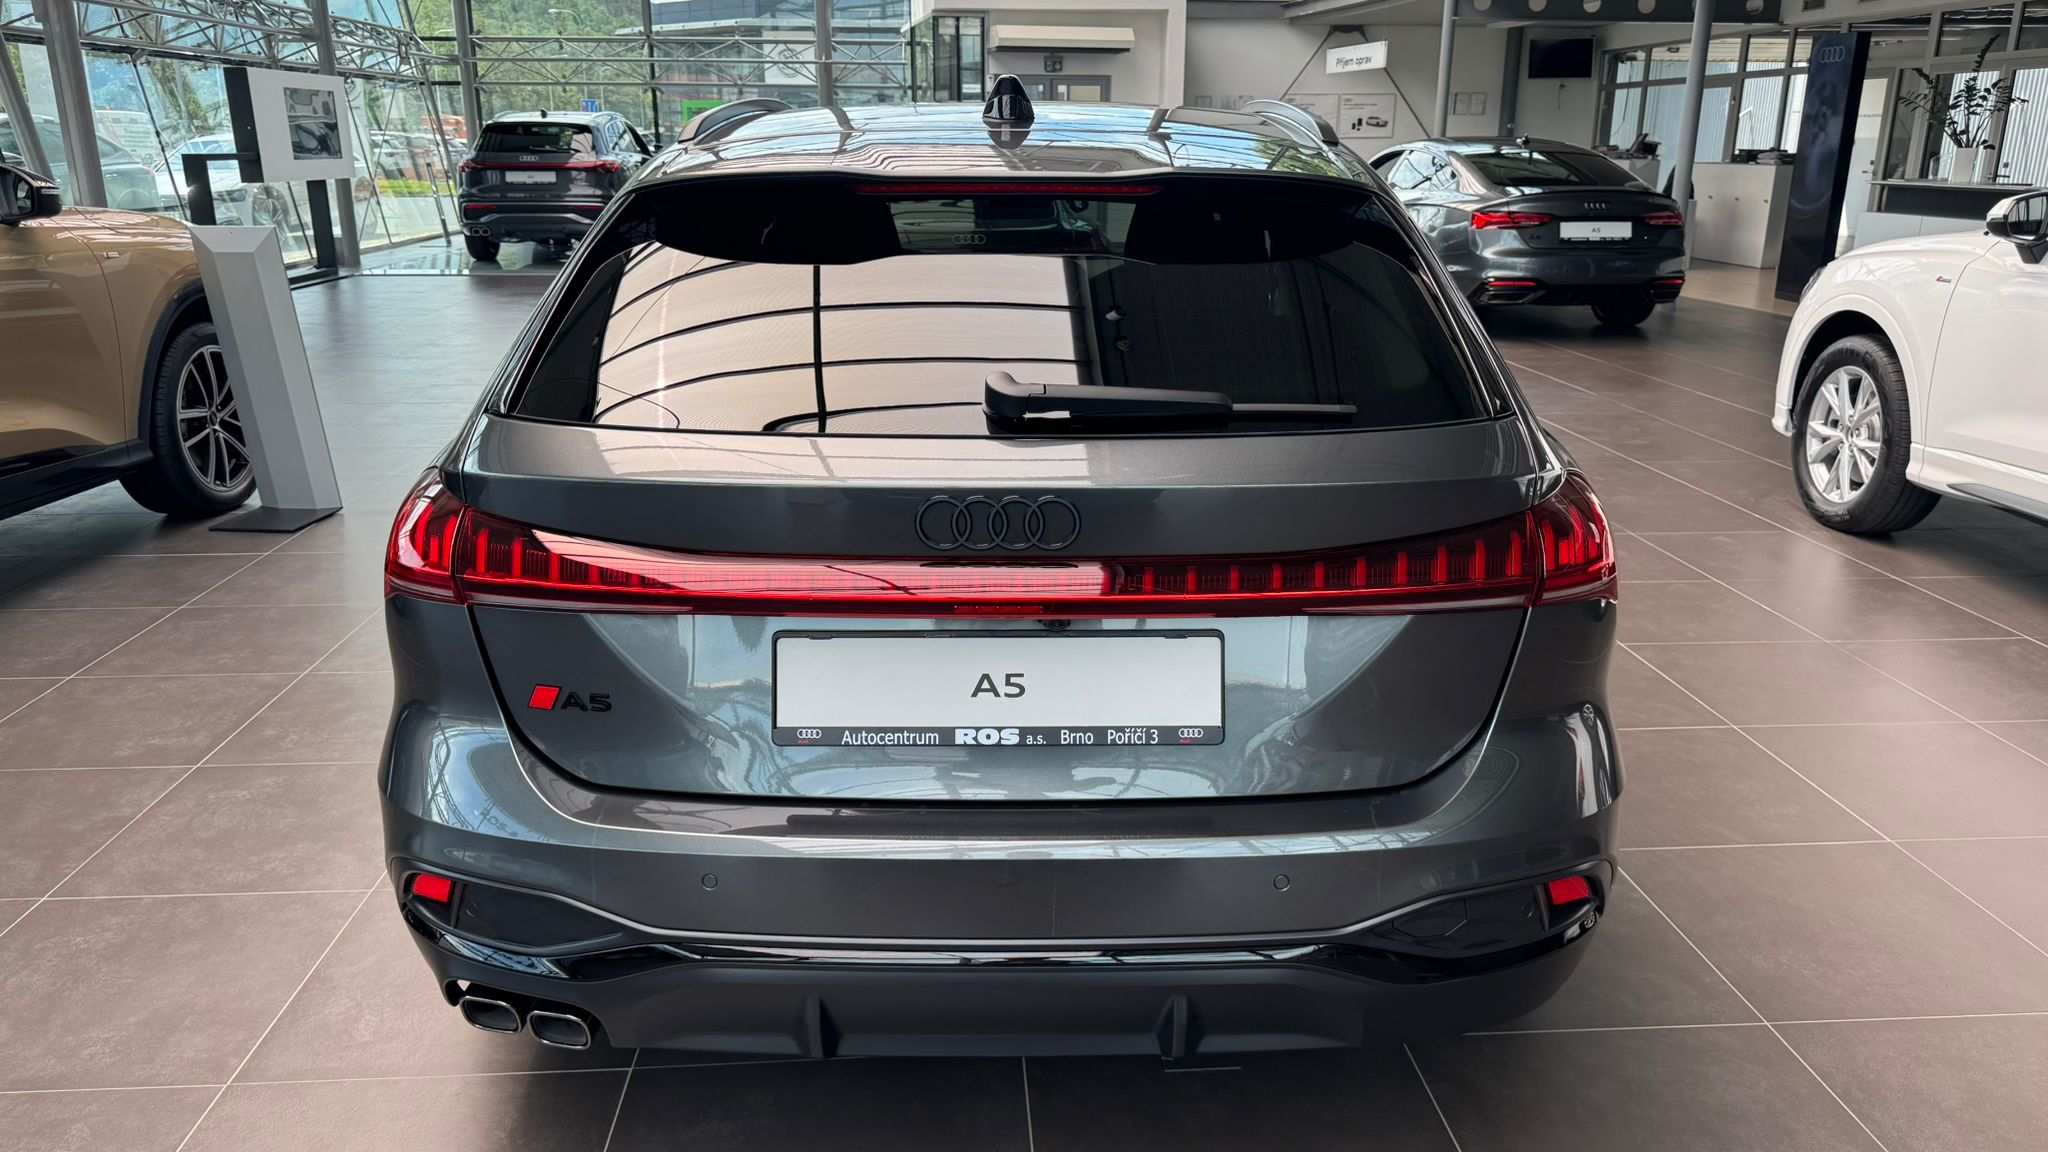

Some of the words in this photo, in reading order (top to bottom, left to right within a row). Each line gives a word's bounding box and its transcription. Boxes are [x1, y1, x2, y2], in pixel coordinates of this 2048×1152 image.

[1355, 56, 1372, 67] oprav
[970, 673, 1026, 698] A5
[560, 691, 612, 712] A5
[841, 729, 939, 745] Autocentrum
[955, 728, 1020, 745] ROS
[1026, 734, 1047, 745] a.s.
[1061, 729, 1094, 745] Brno
[1107, 727, 1147, 745] Poříčí
[1150, 729, 1158, 744] 3
